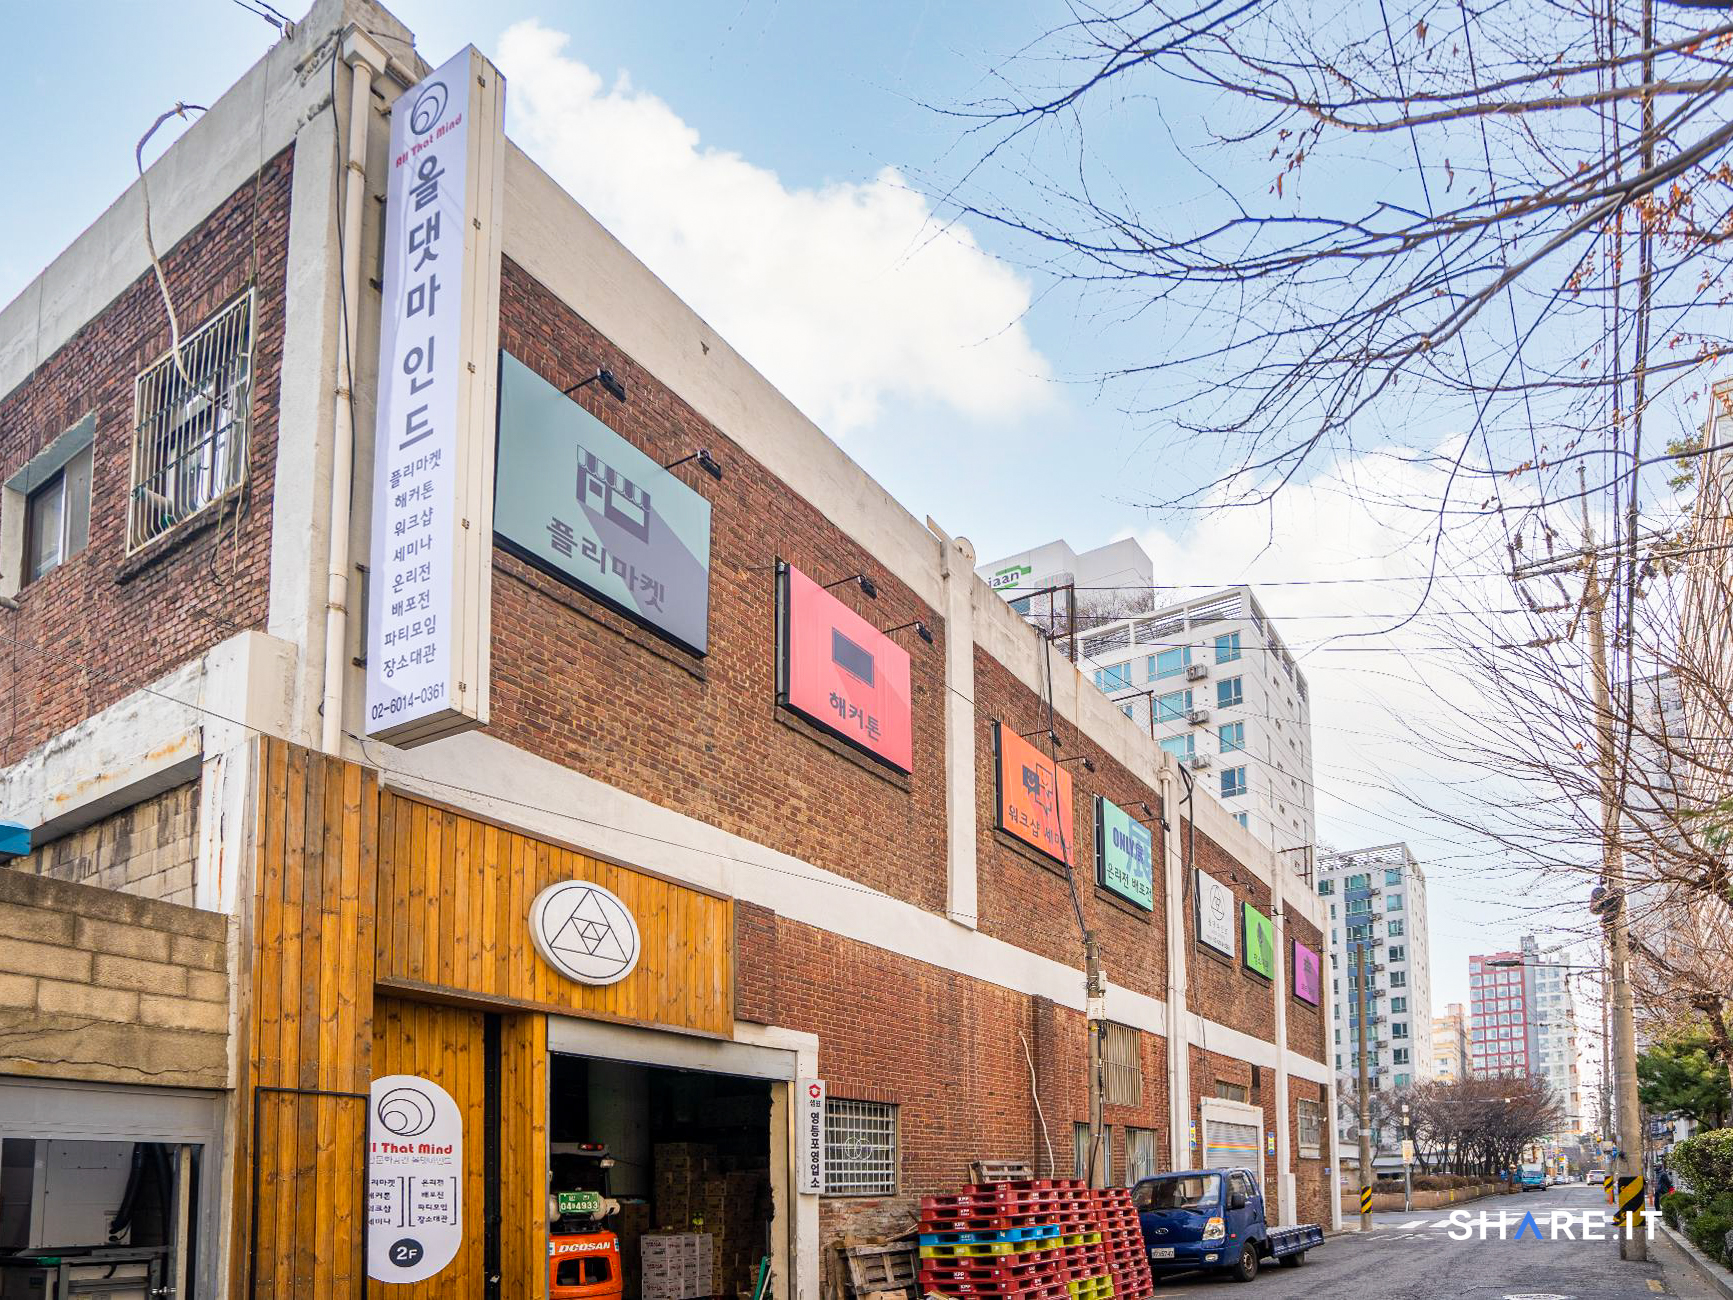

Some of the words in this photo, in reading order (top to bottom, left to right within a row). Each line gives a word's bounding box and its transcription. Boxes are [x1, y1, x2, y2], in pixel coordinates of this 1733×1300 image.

[396, 152, 408, 168] All
[411, 134, 433, 156] That
[437, 113, 462, 139] Mind
[400, 155, 445, 451] 올댓마인드
[390, 449, 441, 489] 플리마켓
[395, 480, 434, 508] 해커톤
[394, 507, 434, 536] 워크샵
[392, 534, 433, 562] 세미나
[392, 561, 431, 593] 온리전
[546, 516, 665, 614] 플리마켓
[391, 590, 430, 617] 배포전
[384, 615, 437, 647] 파티모임
[383, 643, 436, 678] 장소대관
[372, 682, 445, 721] 02-6014-0361
[829, 691, 882, 742] 해커톤
[1009, 804, 1040, 838] 워크샵
[1107, 862, 1129, 889] 온리전
[381, 1143, 413, 1153] That
[418, 1144, 453, 1154] Mind
[371, 1179, 395, 1187] 리마켓
[396, 1246, 418, 1260] 2F
